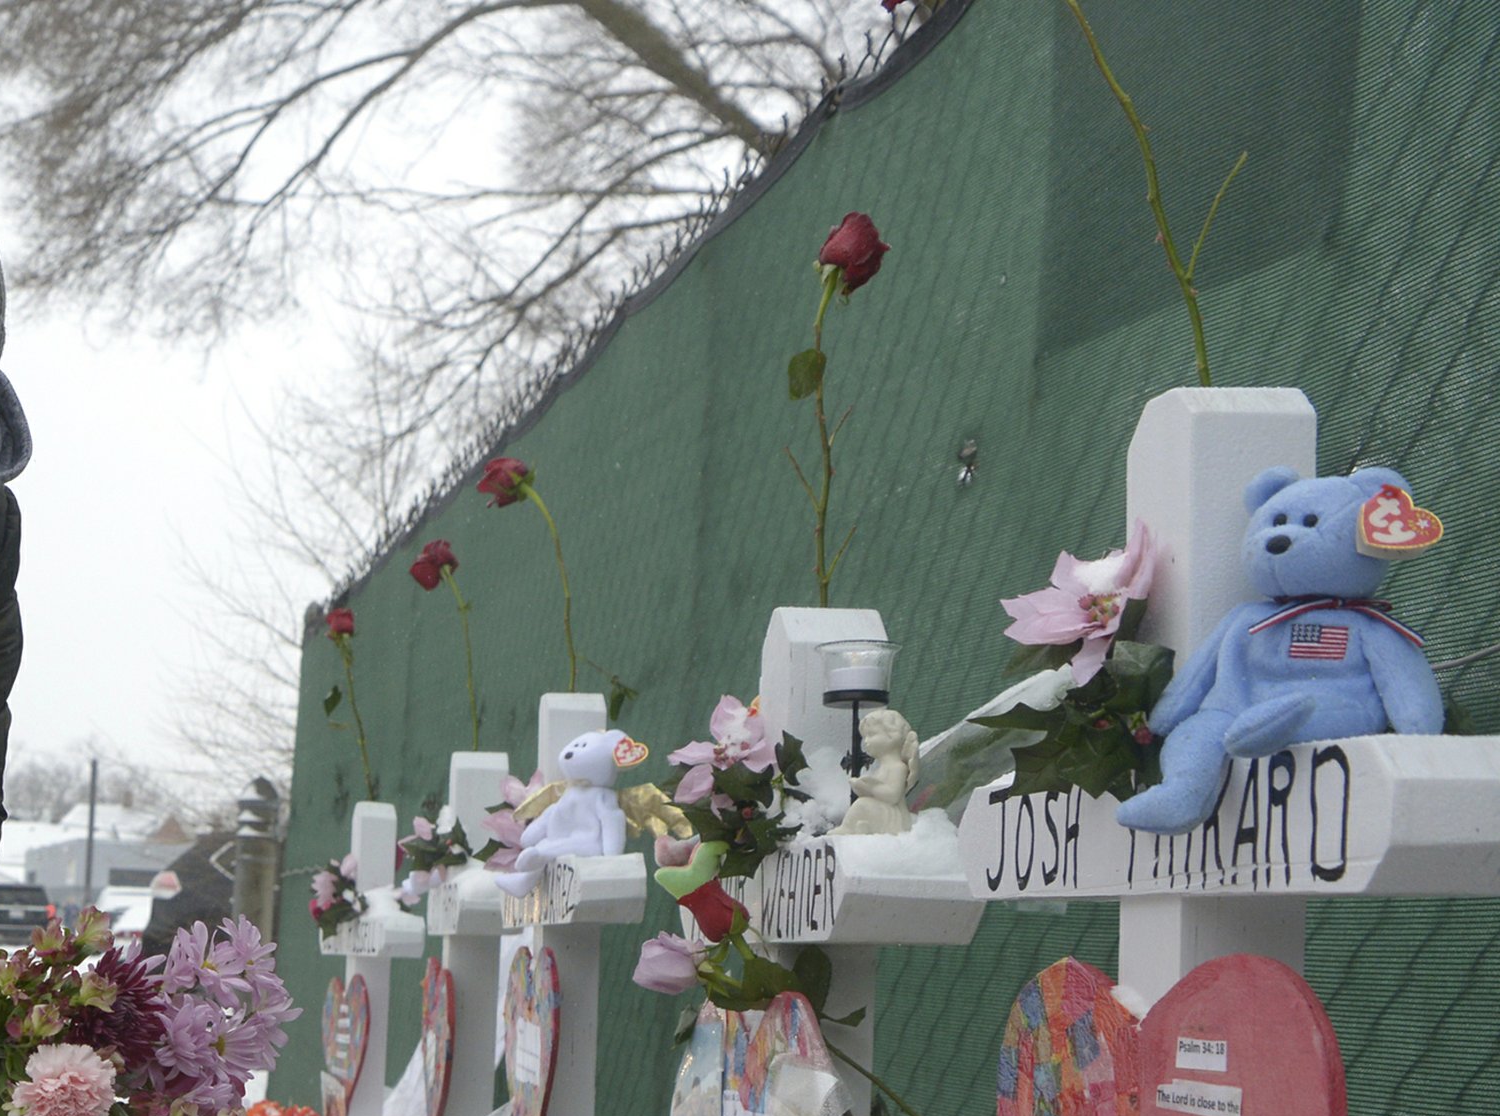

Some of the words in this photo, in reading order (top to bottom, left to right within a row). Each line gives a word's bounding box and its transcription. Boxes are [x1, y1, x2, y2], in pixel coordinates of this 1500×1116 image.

[986, 784, 1082, 892] JOSH
[760, 842, 836, 940] WEHNER
[1179, 1040, 1201, 1054] Psalm
[1202, 1042, 1214, 1054] 34:
[1216, 1043, 1225, 1055] 18
[1157, 1090, 1171, 1103] The
[1172, 1092, 1189, 1106] Lord
[1190, 1095, 1196, 1107] is
[1197, 1096, 1216, 1110] close
[1218, 1100, 1226, 1112] to
[1227, 1100, 1240, 1114] the
